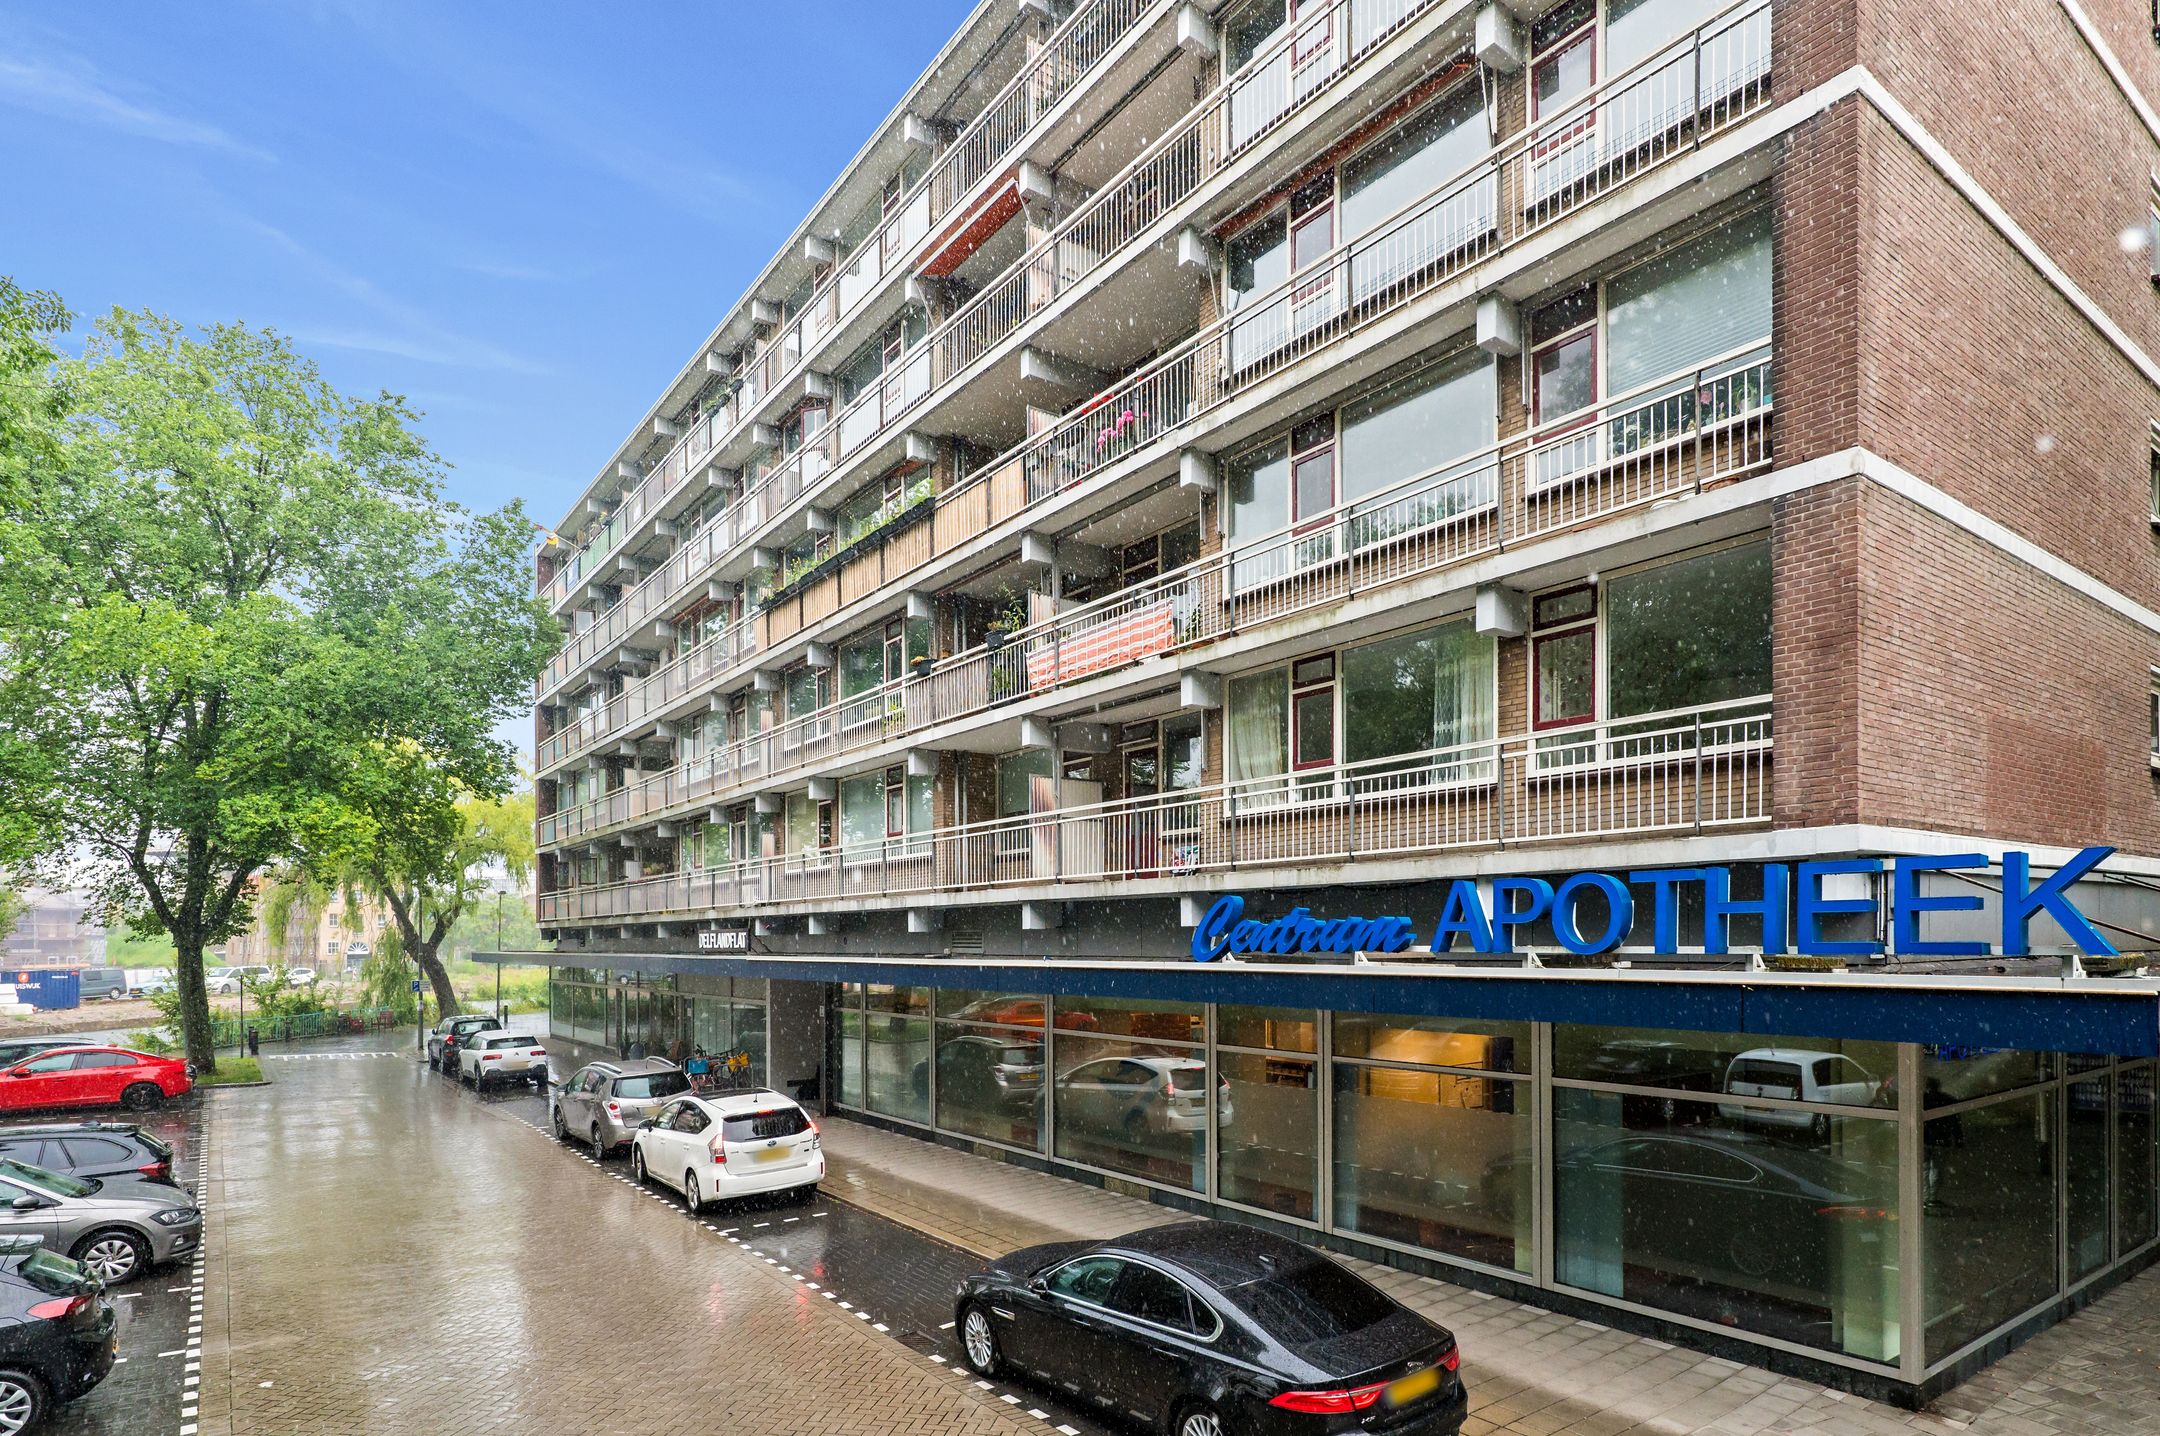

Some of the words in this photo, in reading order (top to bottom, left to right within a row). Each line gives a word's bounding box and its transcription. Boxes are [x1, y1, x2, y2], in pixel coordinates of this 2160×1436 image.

[1191, 895, 1418, 962] Centrum
[1429, 846, 2120, 956] APOTHEEK
[698, 932, 747, 949] DELFLANDFLAT
